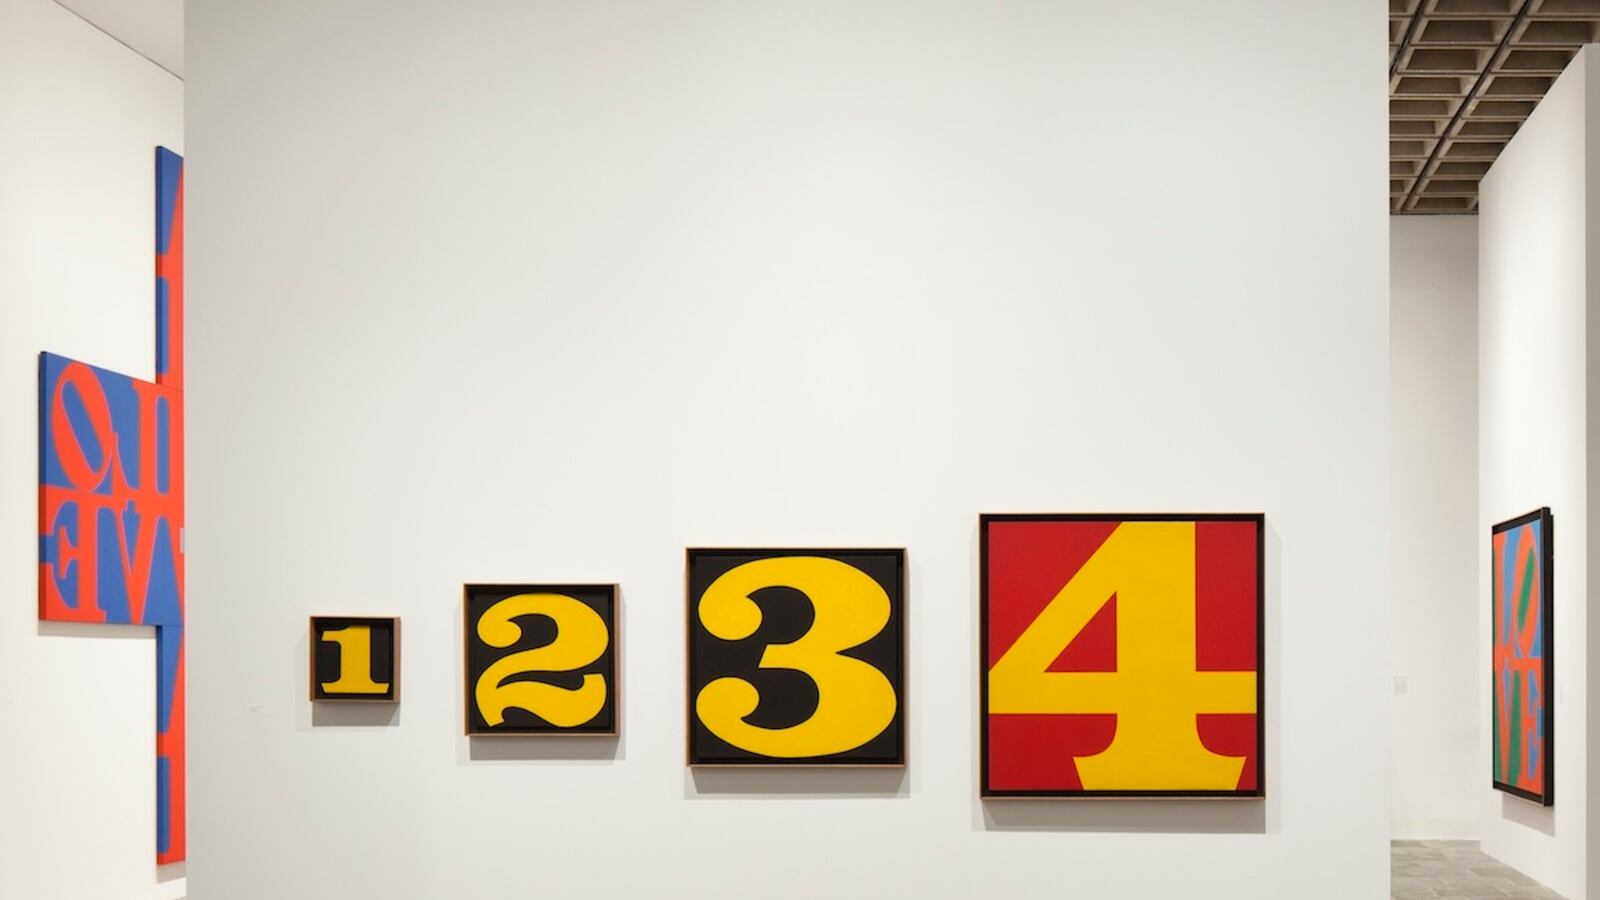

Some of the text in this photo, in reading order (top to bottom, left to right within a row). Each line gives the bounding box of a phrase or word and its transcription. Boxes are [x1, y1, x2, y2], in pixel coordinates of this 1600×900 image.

[321, 626, 389, 695] 1
[476, 594, 608, 728] 2
[696, 556, 897, 758] 3
[989, 522, 1257, 791] 4
